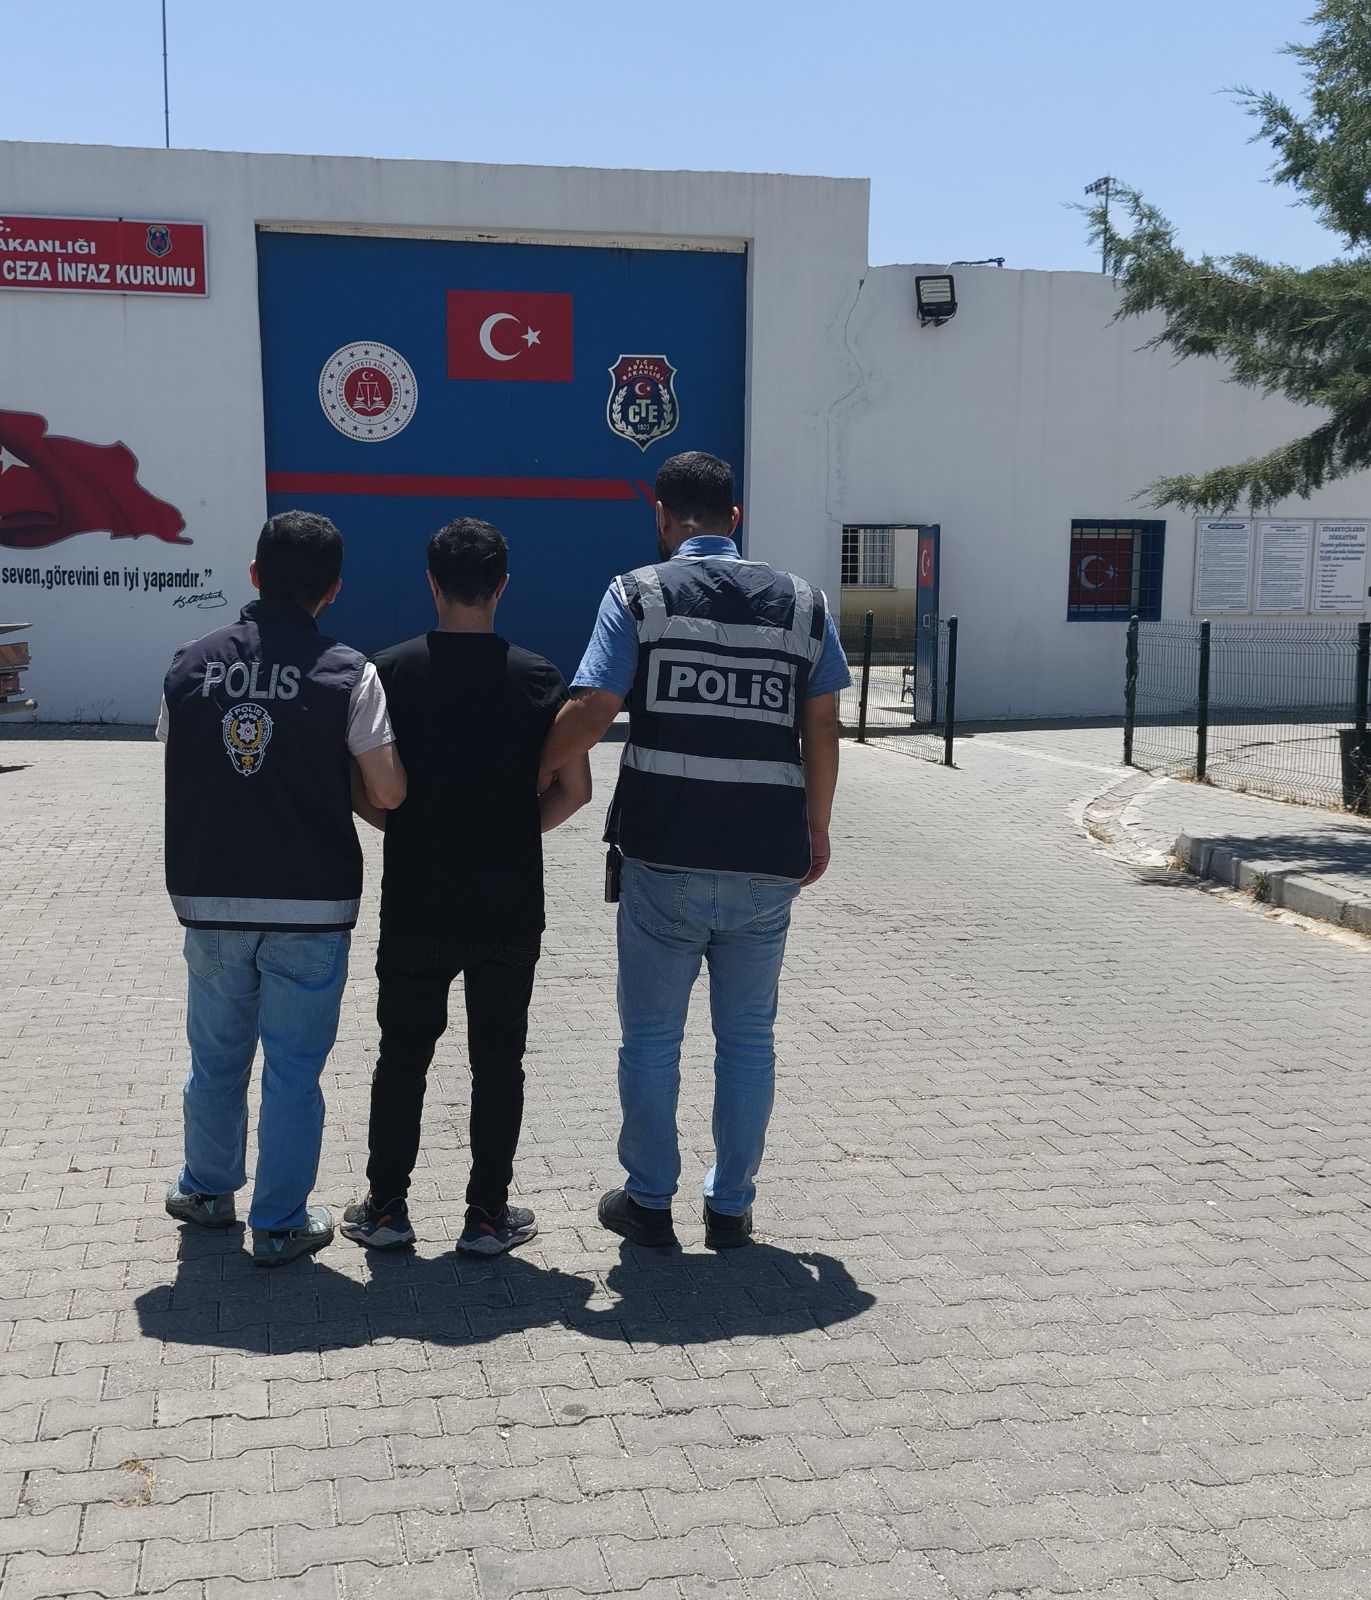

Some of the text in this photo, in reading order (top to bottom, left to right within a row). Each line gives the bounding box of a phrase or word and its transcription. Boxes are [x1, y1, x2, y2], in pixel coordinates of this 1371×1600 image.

[3, 258, 196, 287] CEZA İNFAZ KURUMU
[373, 362, 395, 380] ADALET
[628, 364, 660, 372] ADALET
[628, 399, 658, 423] CTE
[103, 568, 120, 587] en
[124, 567, 139, 592] iyi
